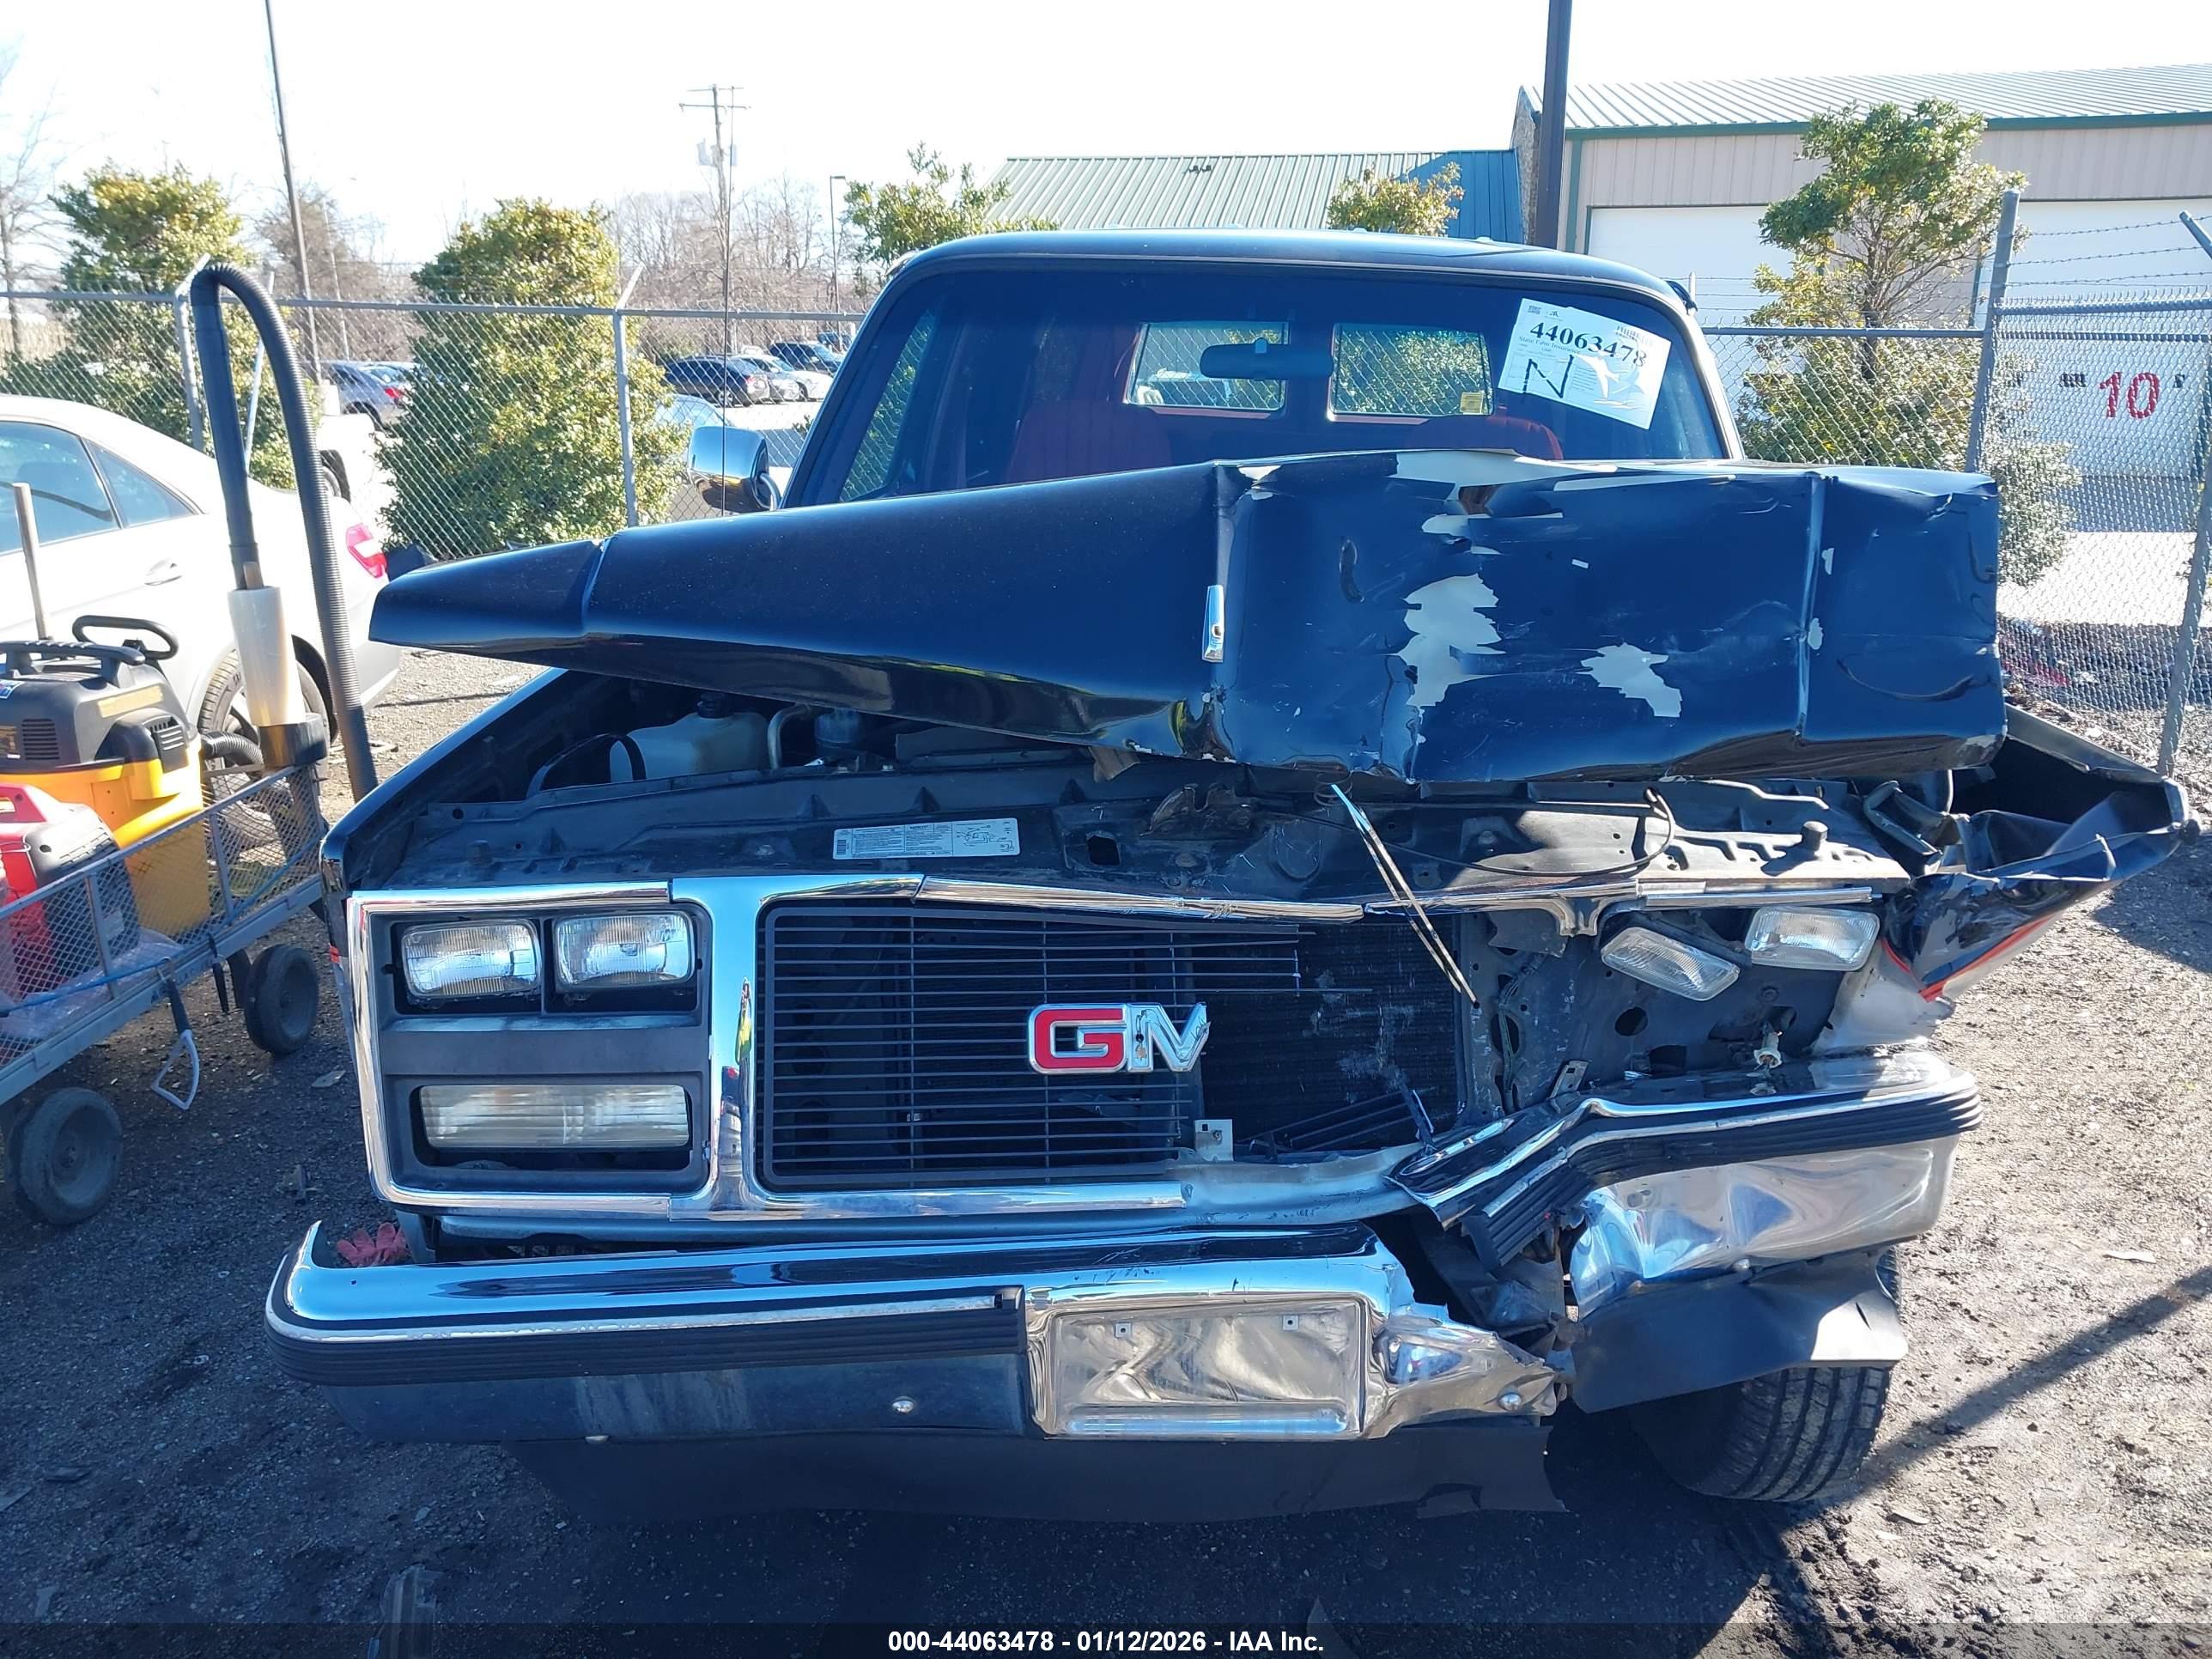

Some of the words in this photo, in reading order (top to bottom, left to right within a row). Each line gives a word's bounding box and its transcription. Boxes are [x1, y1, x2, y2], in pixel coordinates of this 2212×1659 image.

[1530, 322, 1647, 368] 44063478
[1522, 354, 1574, 398] N
[2098, 372, 2160, 419] 10
